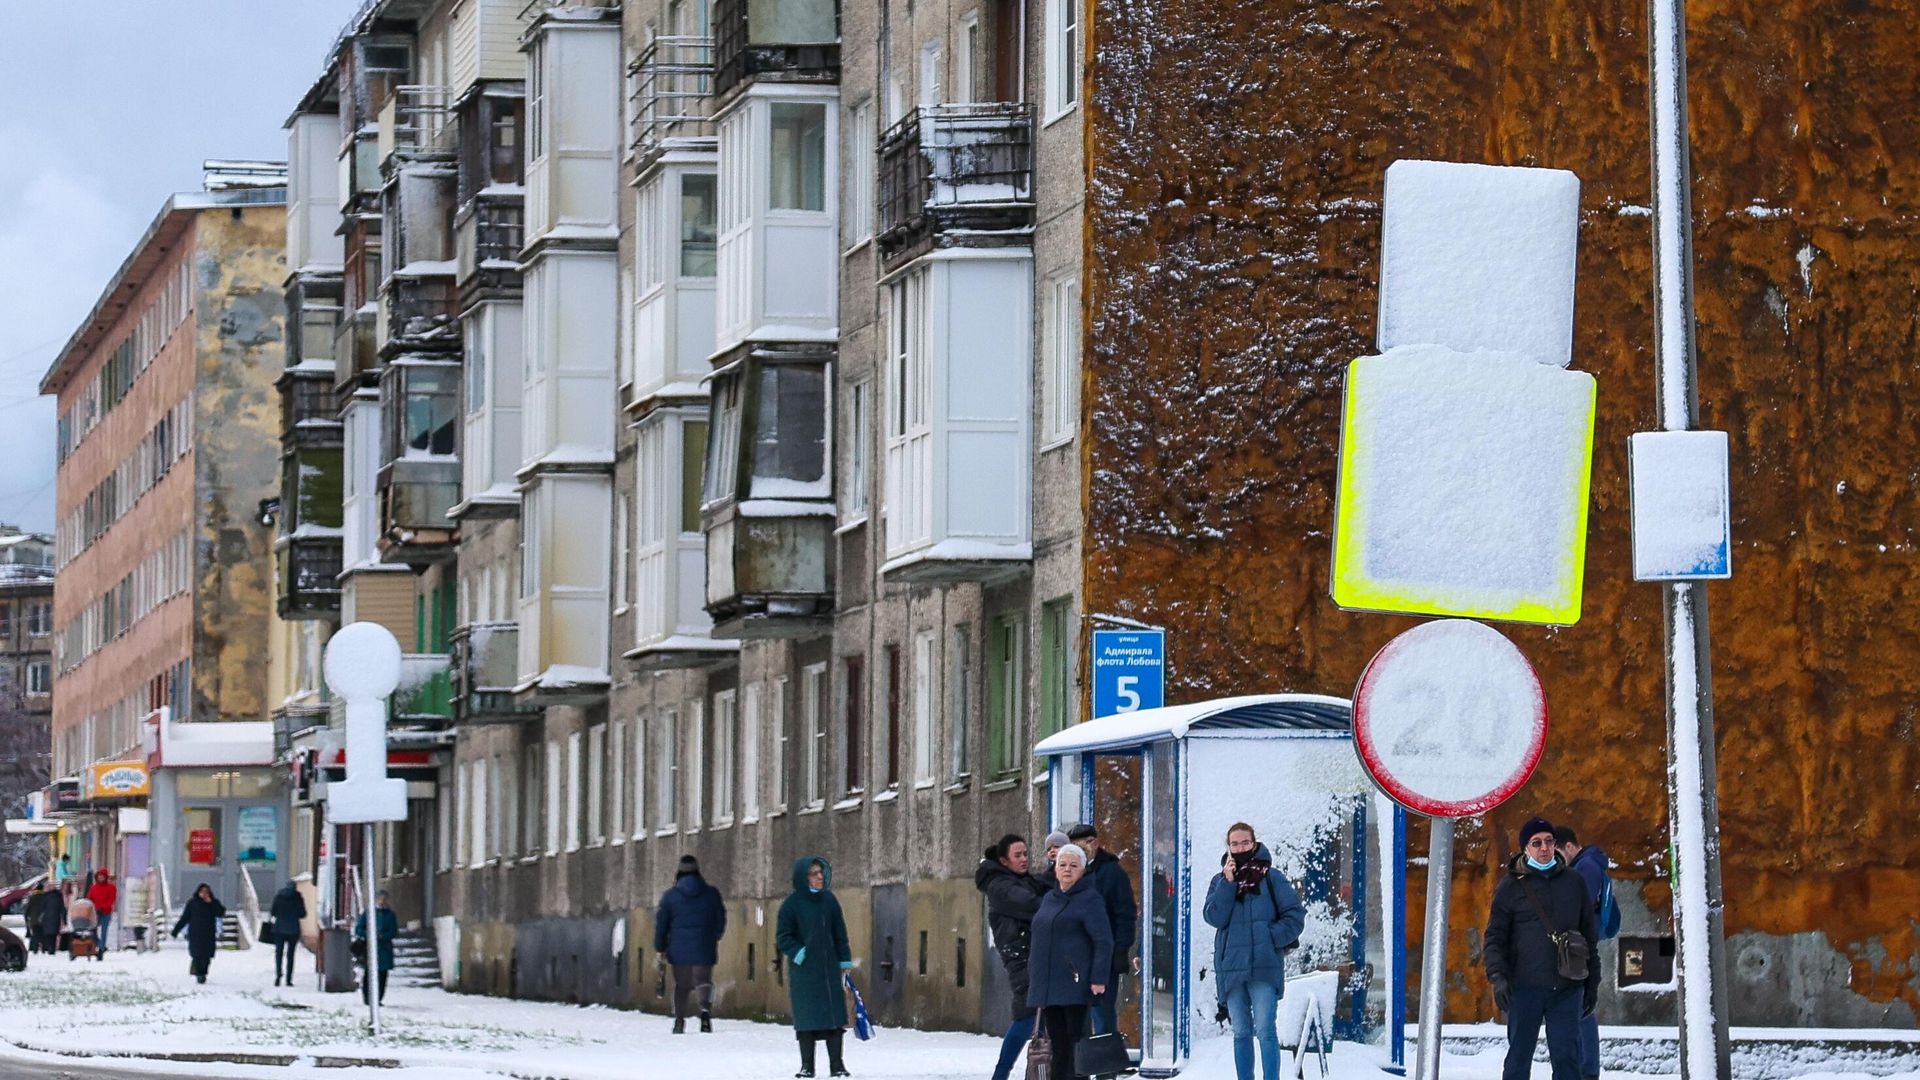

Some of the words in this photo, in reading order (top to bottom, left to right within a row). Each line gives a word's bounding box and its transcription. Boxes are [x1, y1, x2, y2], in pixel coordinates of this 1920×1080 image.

[1096, 656, 1125, 667] флота
[1126, 656, 1161, 666] Лобова
[1104, 646, 1153, 657] Адмирала
[1116, 675, 1141, 714] 5
[1391, 679, 1511, 758] 20
